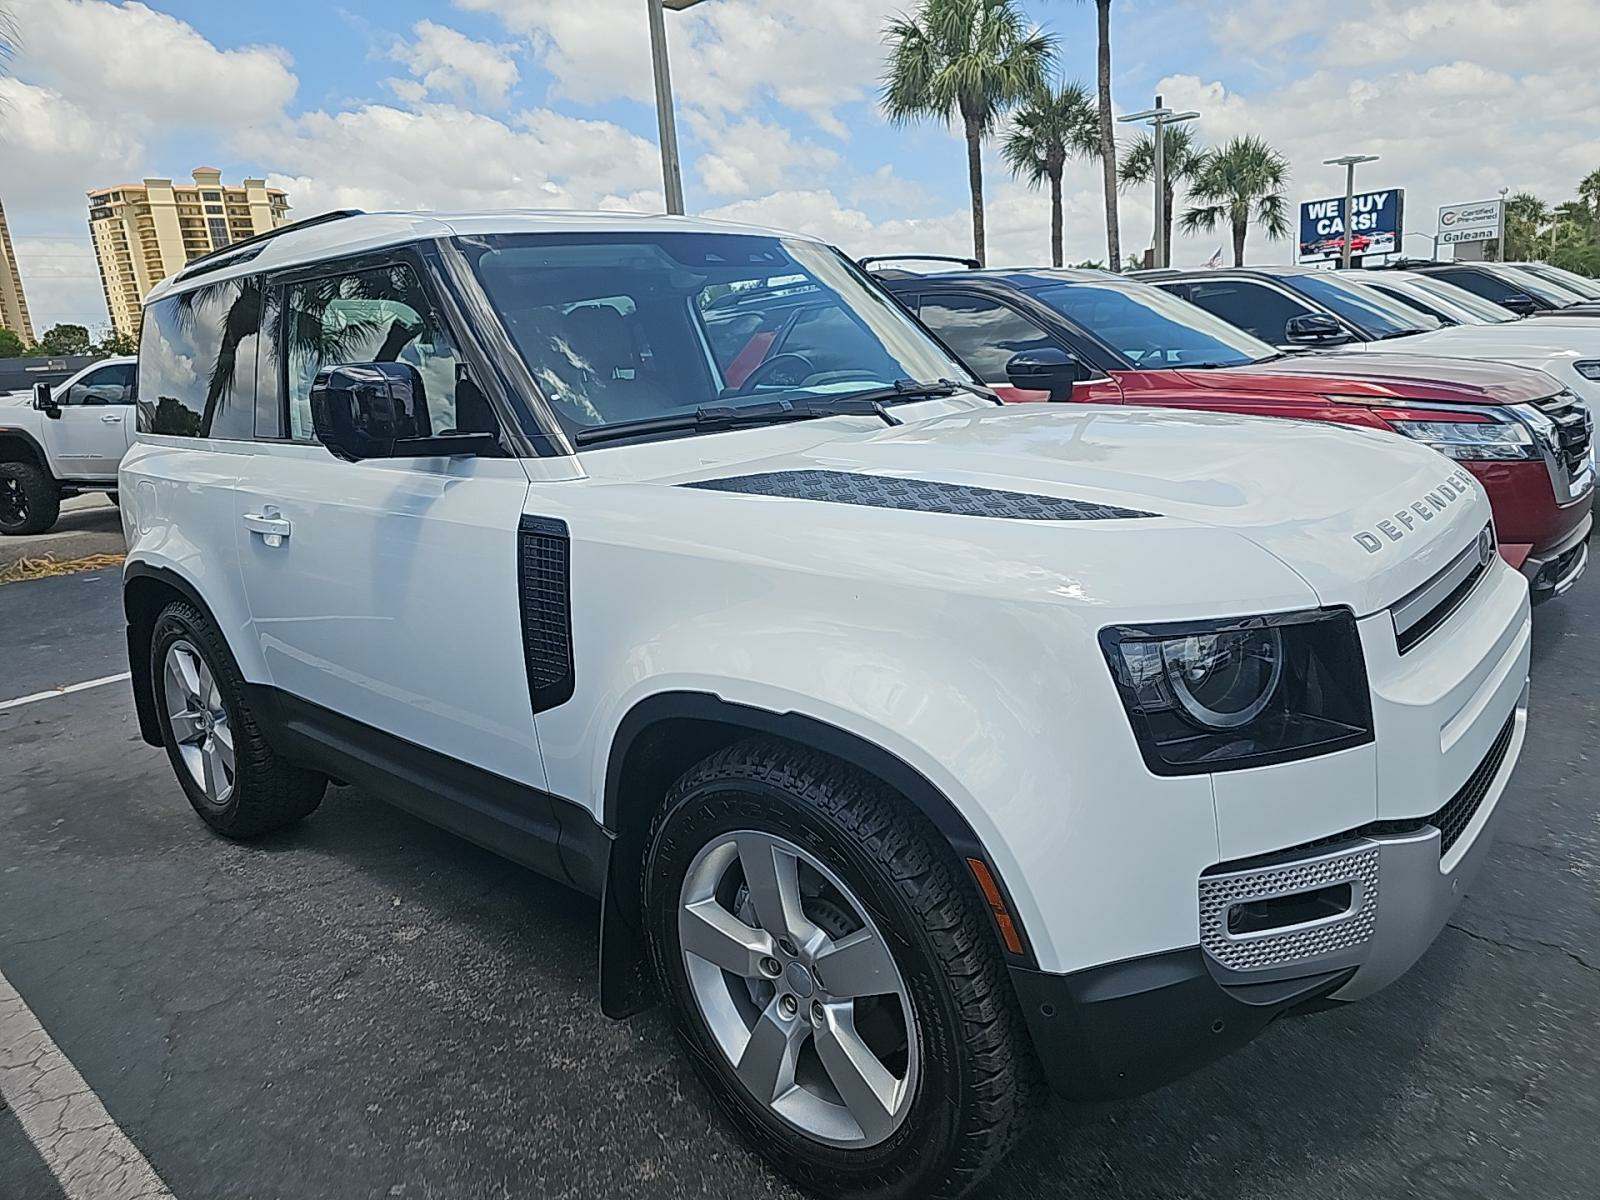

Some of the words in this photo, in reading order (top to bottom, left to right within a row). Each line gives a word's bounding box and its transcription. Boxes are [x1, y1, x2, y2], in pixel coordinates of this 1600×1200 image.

[1308, 200, 1339, 220] WE
[1461, 207, 1494, 217] Certified
[1443, 230, 1493, 242] Galeana
[1352, 469, 1473, 553] DEFENDER
